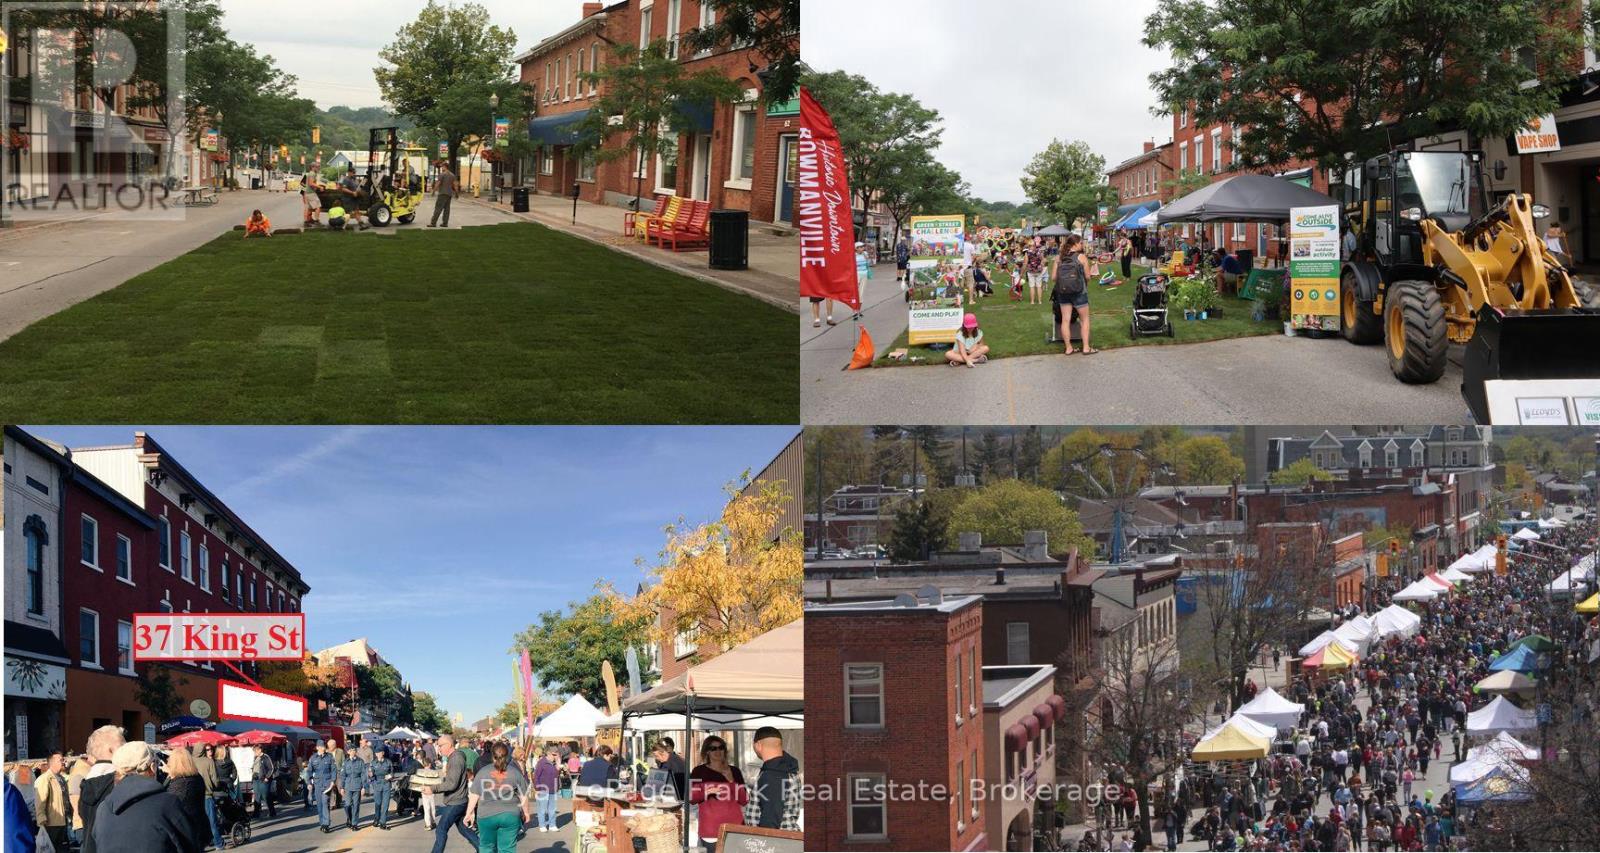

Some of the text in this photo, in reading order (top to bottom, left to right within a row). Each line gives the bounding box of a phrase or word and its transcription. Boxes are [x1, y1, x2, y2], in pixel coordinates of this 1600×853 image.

[1517, 134, 1557, 149] VAPE SHOP
[816, 139, 845, 255] Historic Downtown
